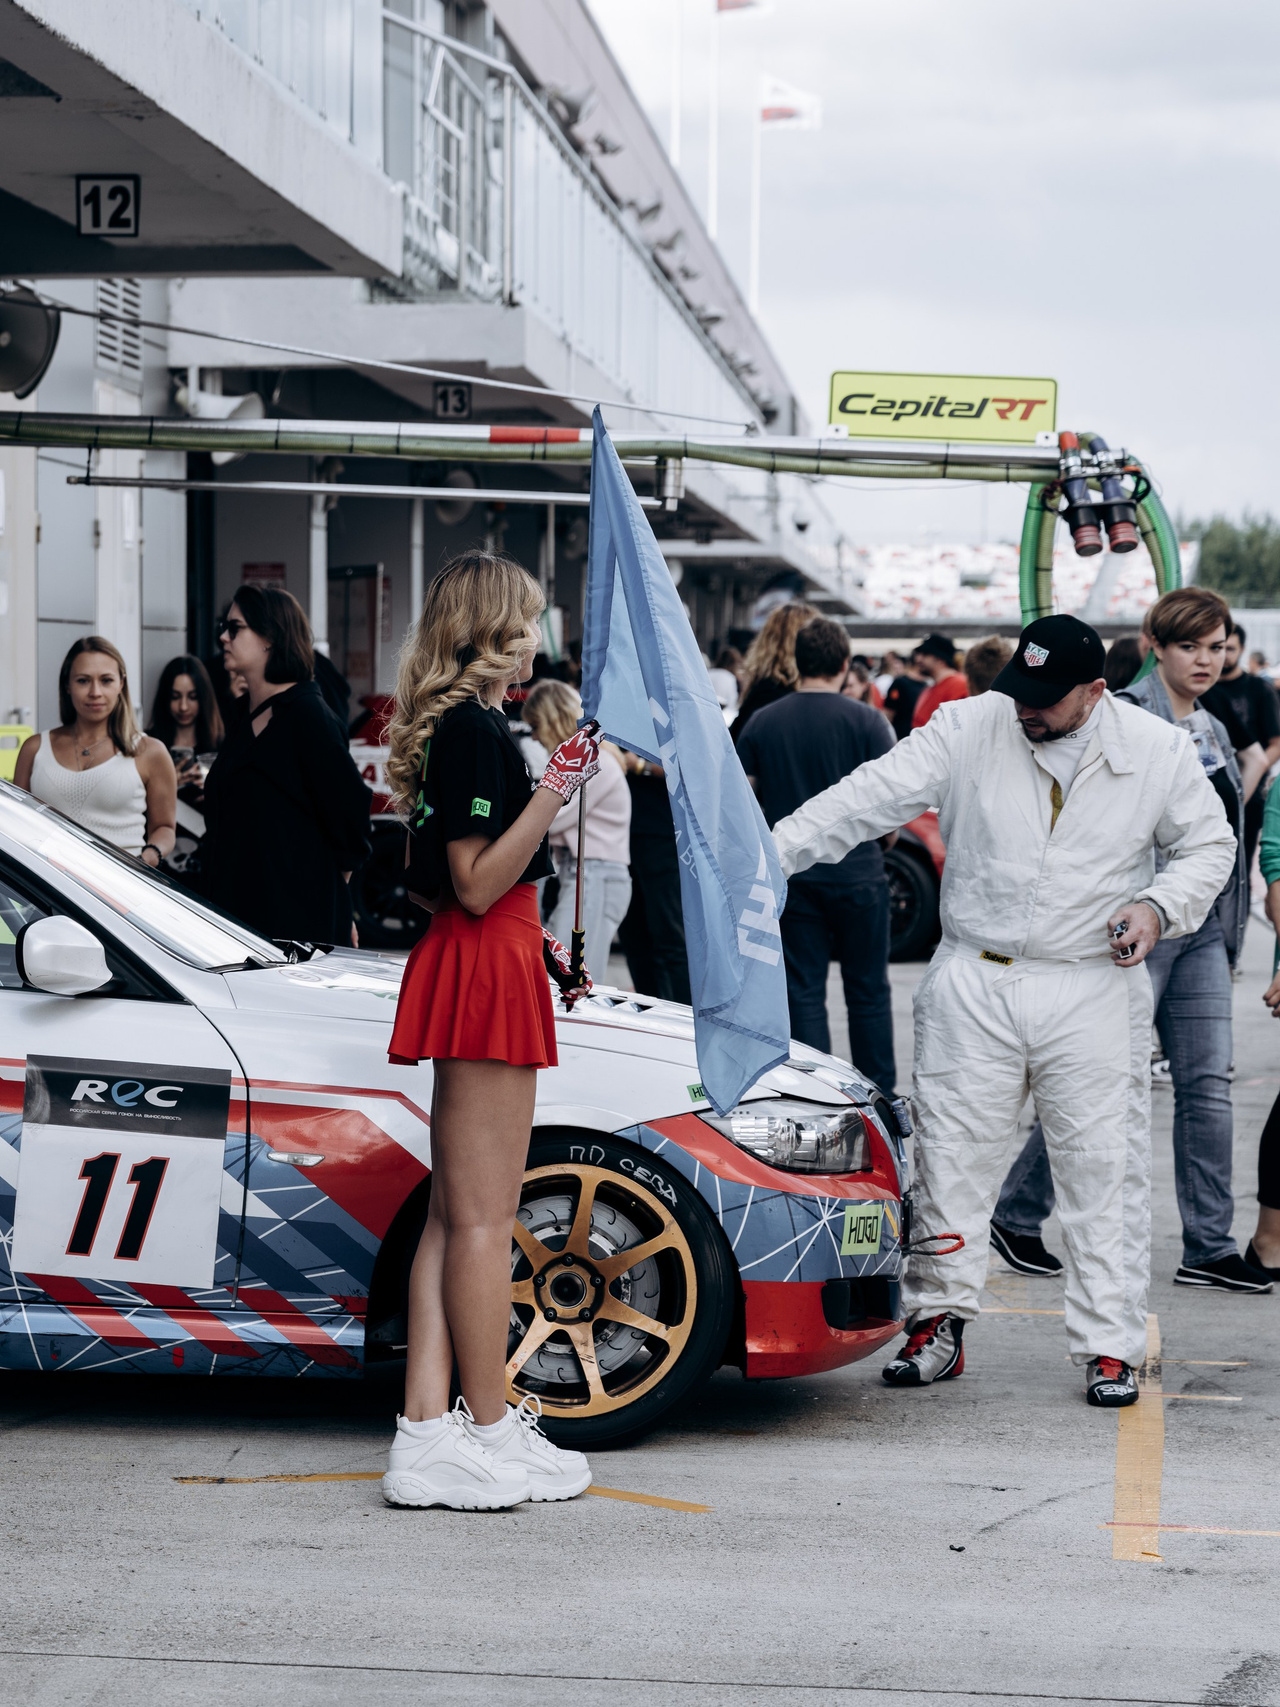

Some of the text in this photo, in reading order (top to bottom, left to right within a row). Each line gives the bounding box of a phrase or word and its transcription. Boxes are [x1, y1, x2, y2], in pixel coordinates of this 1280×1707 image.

[83, 185, 131, 228] 12
[439, 388, 466, 413] 13
[838, 393, 1048, 421] CapitalRT
[65, 1152, 170, 1261] 11
[848, 1216, 879, 1244] HOGO
